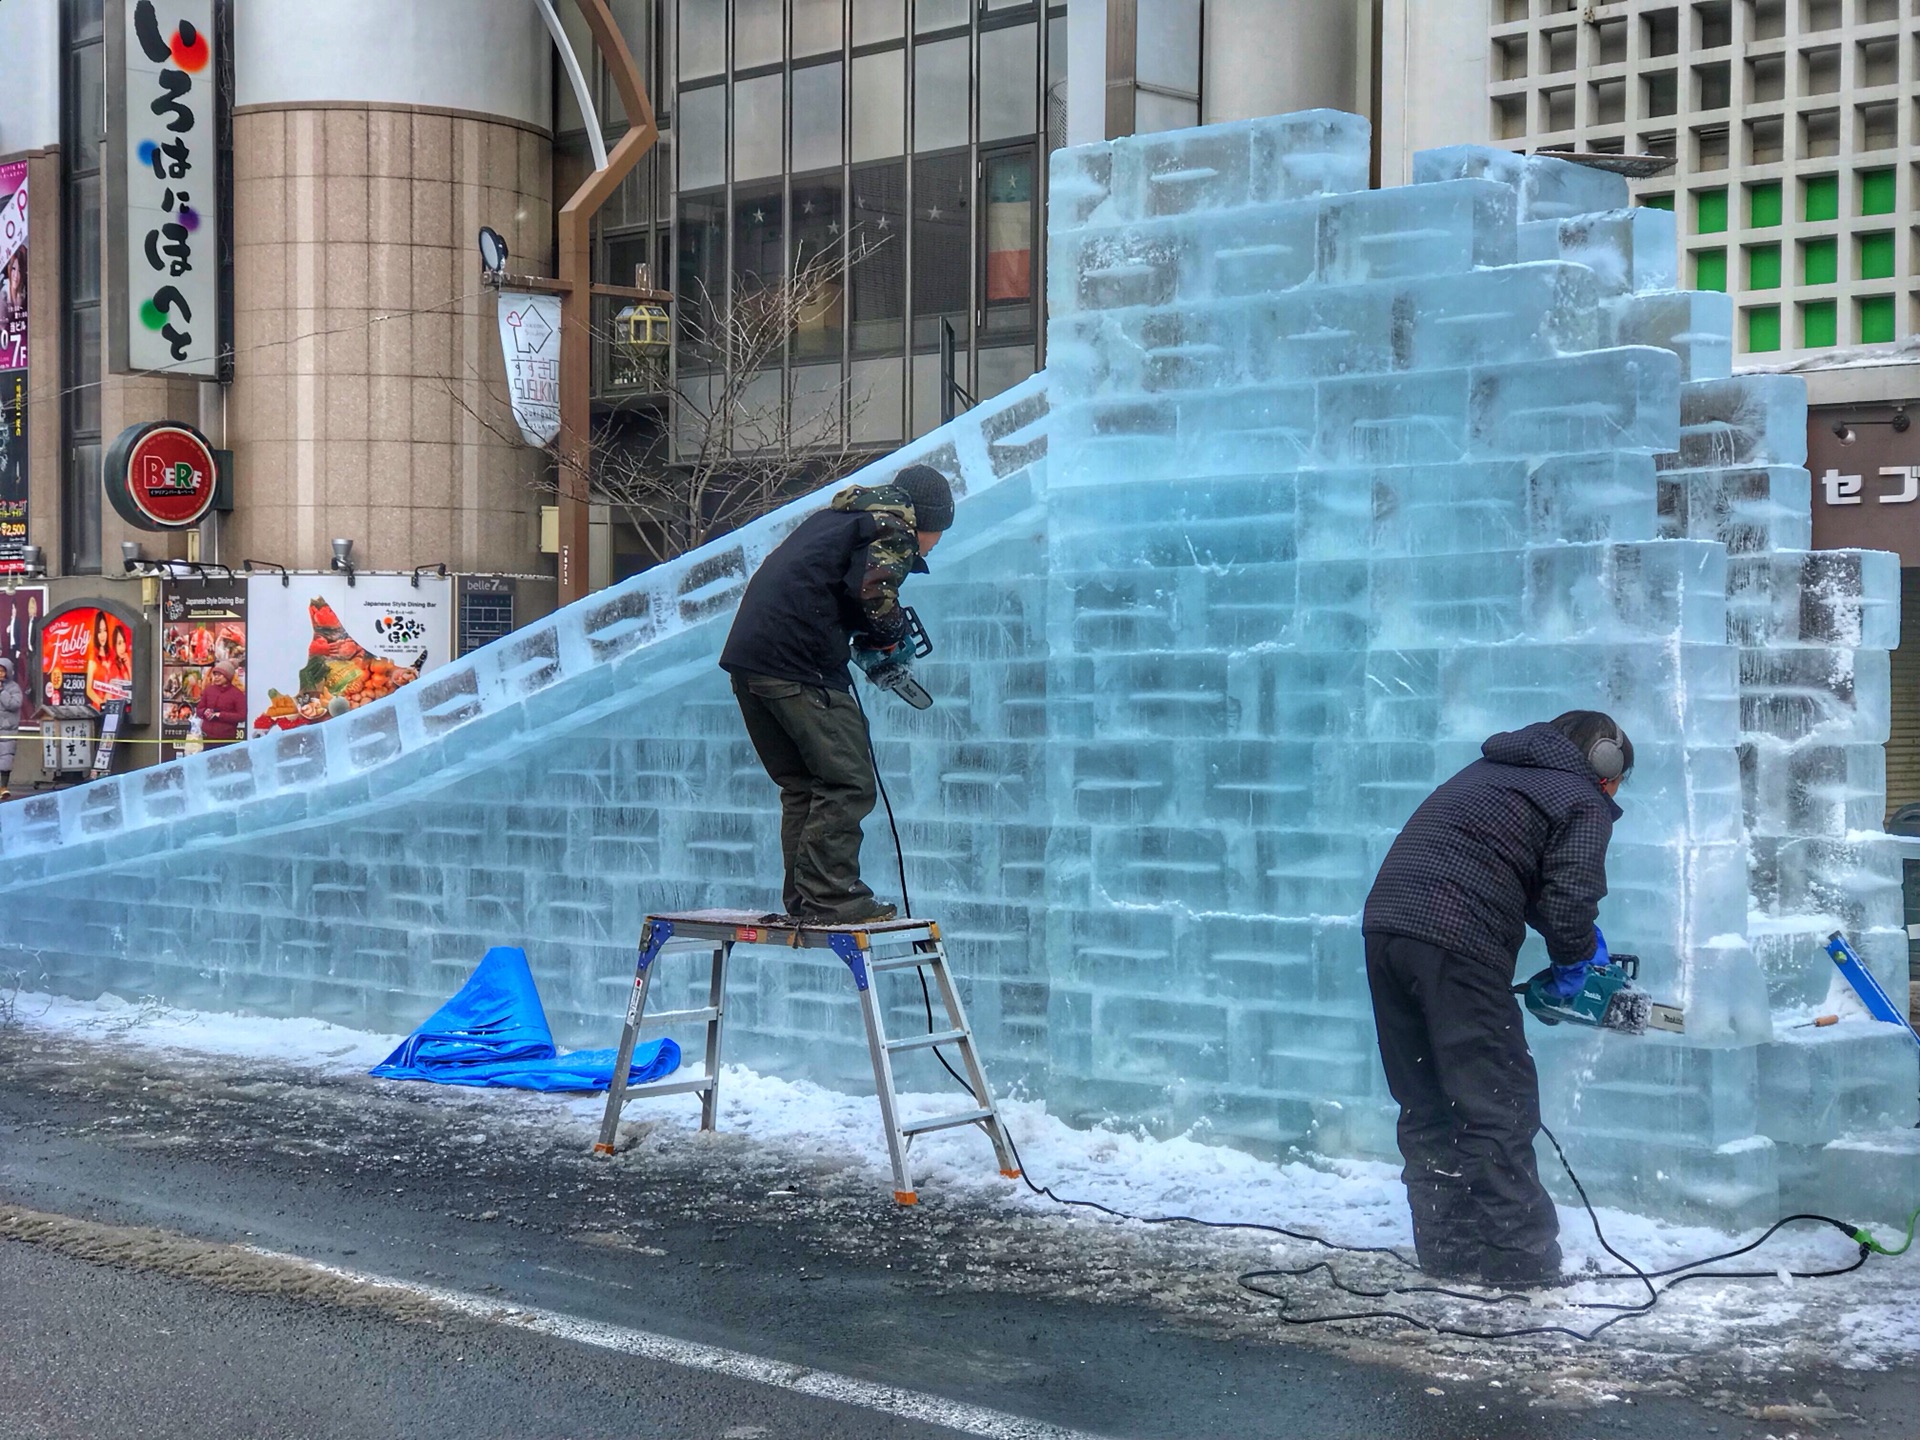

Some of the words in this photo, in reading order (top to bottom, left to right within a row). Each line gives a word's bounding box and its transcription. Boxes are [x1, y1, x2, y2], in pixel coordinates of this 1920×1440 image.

[134, 0, 196, 361] いろはにほへと
[10, 334, 27, 367] 7F
[144, 455, 203, 489] BERE
[185, 598, 206, 606] Japanese
[206, 597, 217, 606] Style
[218, 597, 234, 606] Dining
[47, 622, 92, 675] Fabby
